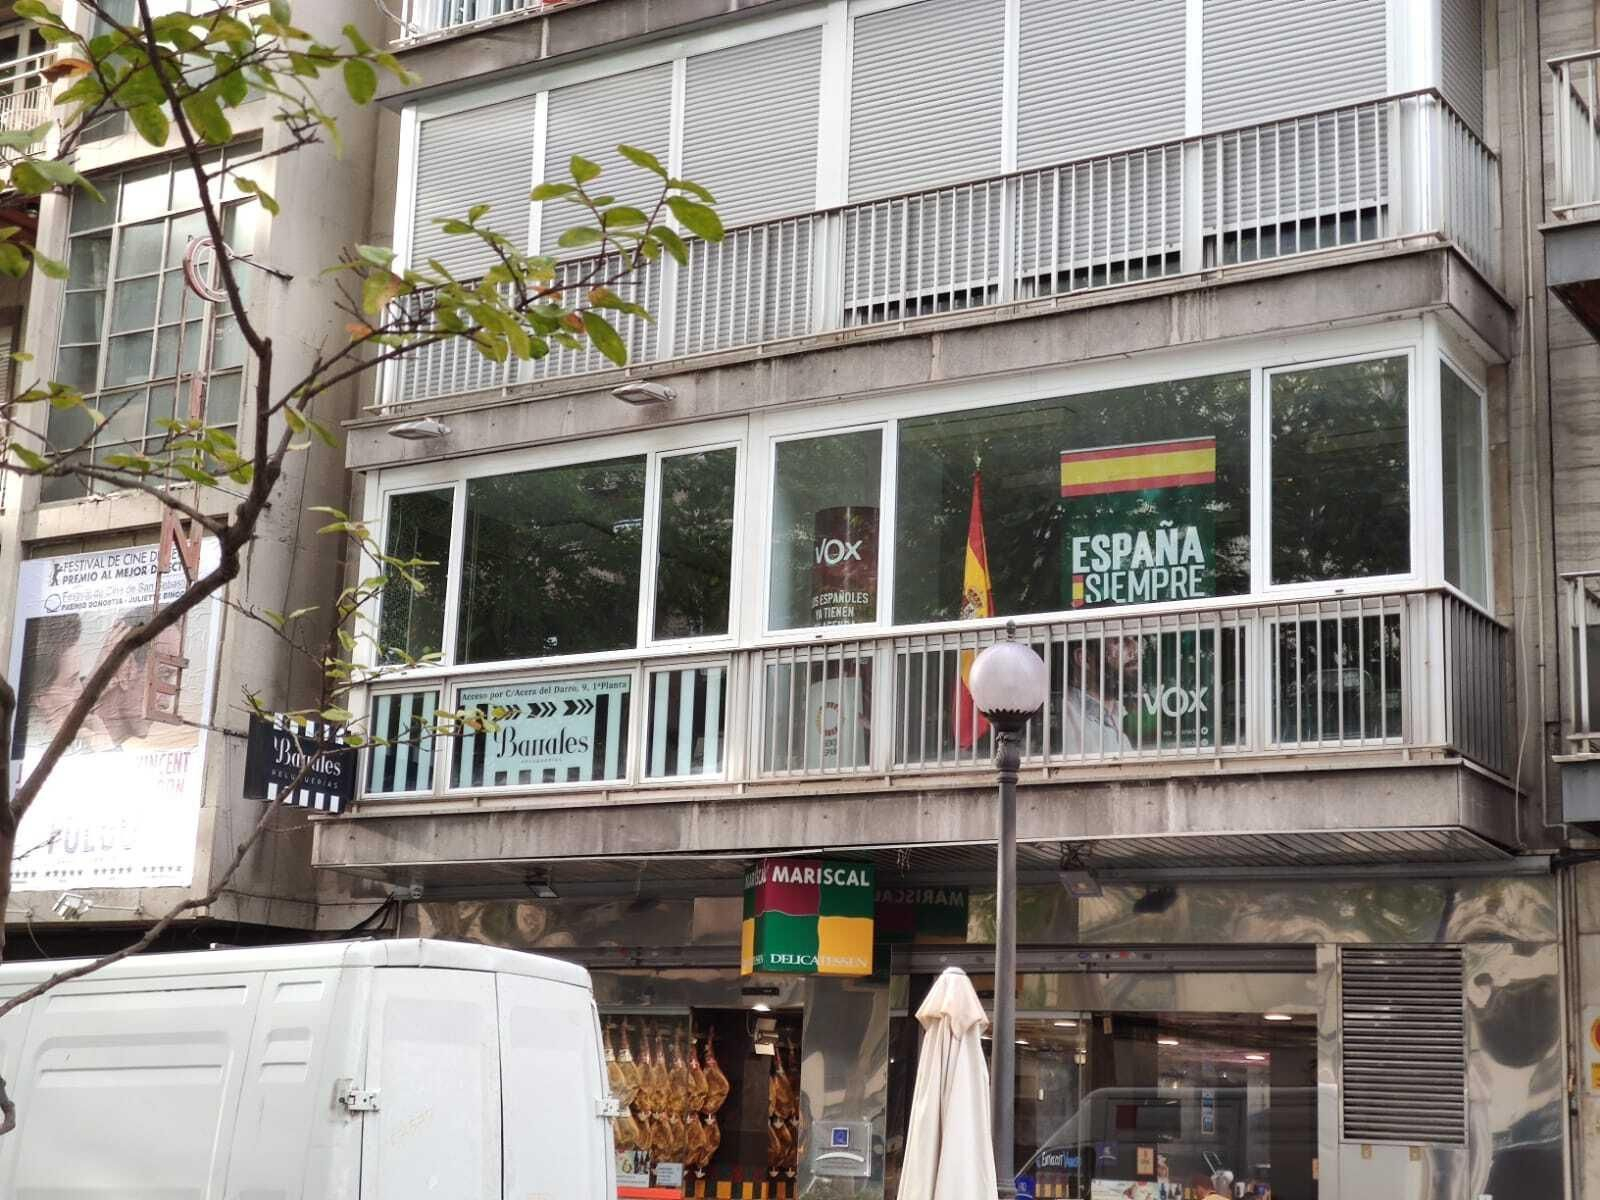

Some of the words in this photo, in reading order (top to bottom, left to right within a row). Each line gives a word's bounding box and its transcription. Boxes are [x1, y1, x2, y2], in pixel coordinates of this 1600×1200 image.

[815, 538, 863, 565] VOX
[1072, 520, 1205, 573] ESPAÑA
[63, 558, 105, 573] FESTIVAL
[108, 555, 120, 568] DE
[123, 552, 148, 566] CINE
[62, 573, 98, 585] PREMIO
[101, 570, 112, 580] AL
[115, 565, 149, 579] MEJOR
[1084, 564, 1206, 603] SIEMPRE
[820, 590, 869, 606] ESPAÑOLES
[824, 606, 855, 620] TIENEN
[490, 691, 503, 700] por
[539, 687, 551, 695] del
[1142, 684, 1208, 717] VOX
[771, 865, 870, 887] MARISCAL
[770, 953, 868, 968] DELICATESSEN
